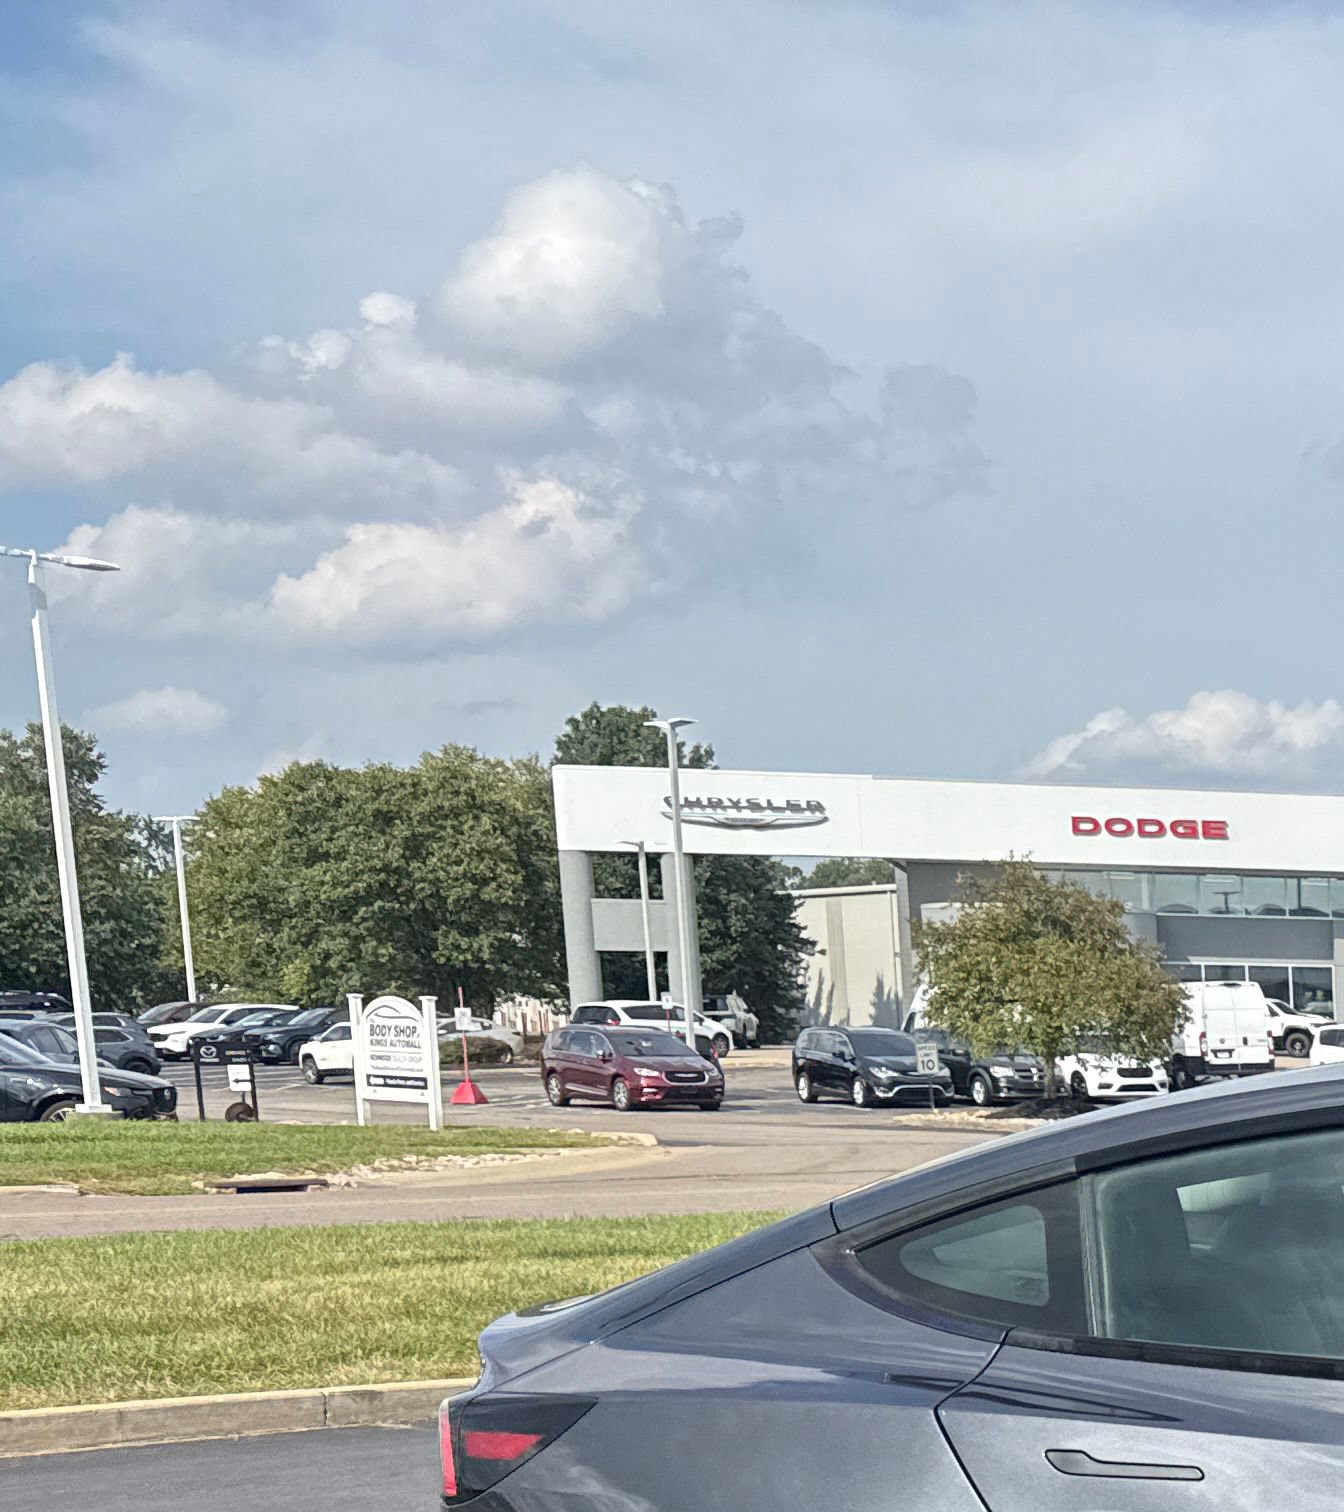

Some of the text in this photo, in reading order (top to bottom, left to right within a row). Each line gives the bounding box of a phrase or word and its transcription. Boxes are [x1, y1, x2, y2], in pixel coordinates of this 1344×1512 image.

[1071, 816, 1229, 840] DODGE
[370, 1024, 417, 1038] BODY SHOP
[921, 1059, 935, 1070] 10
